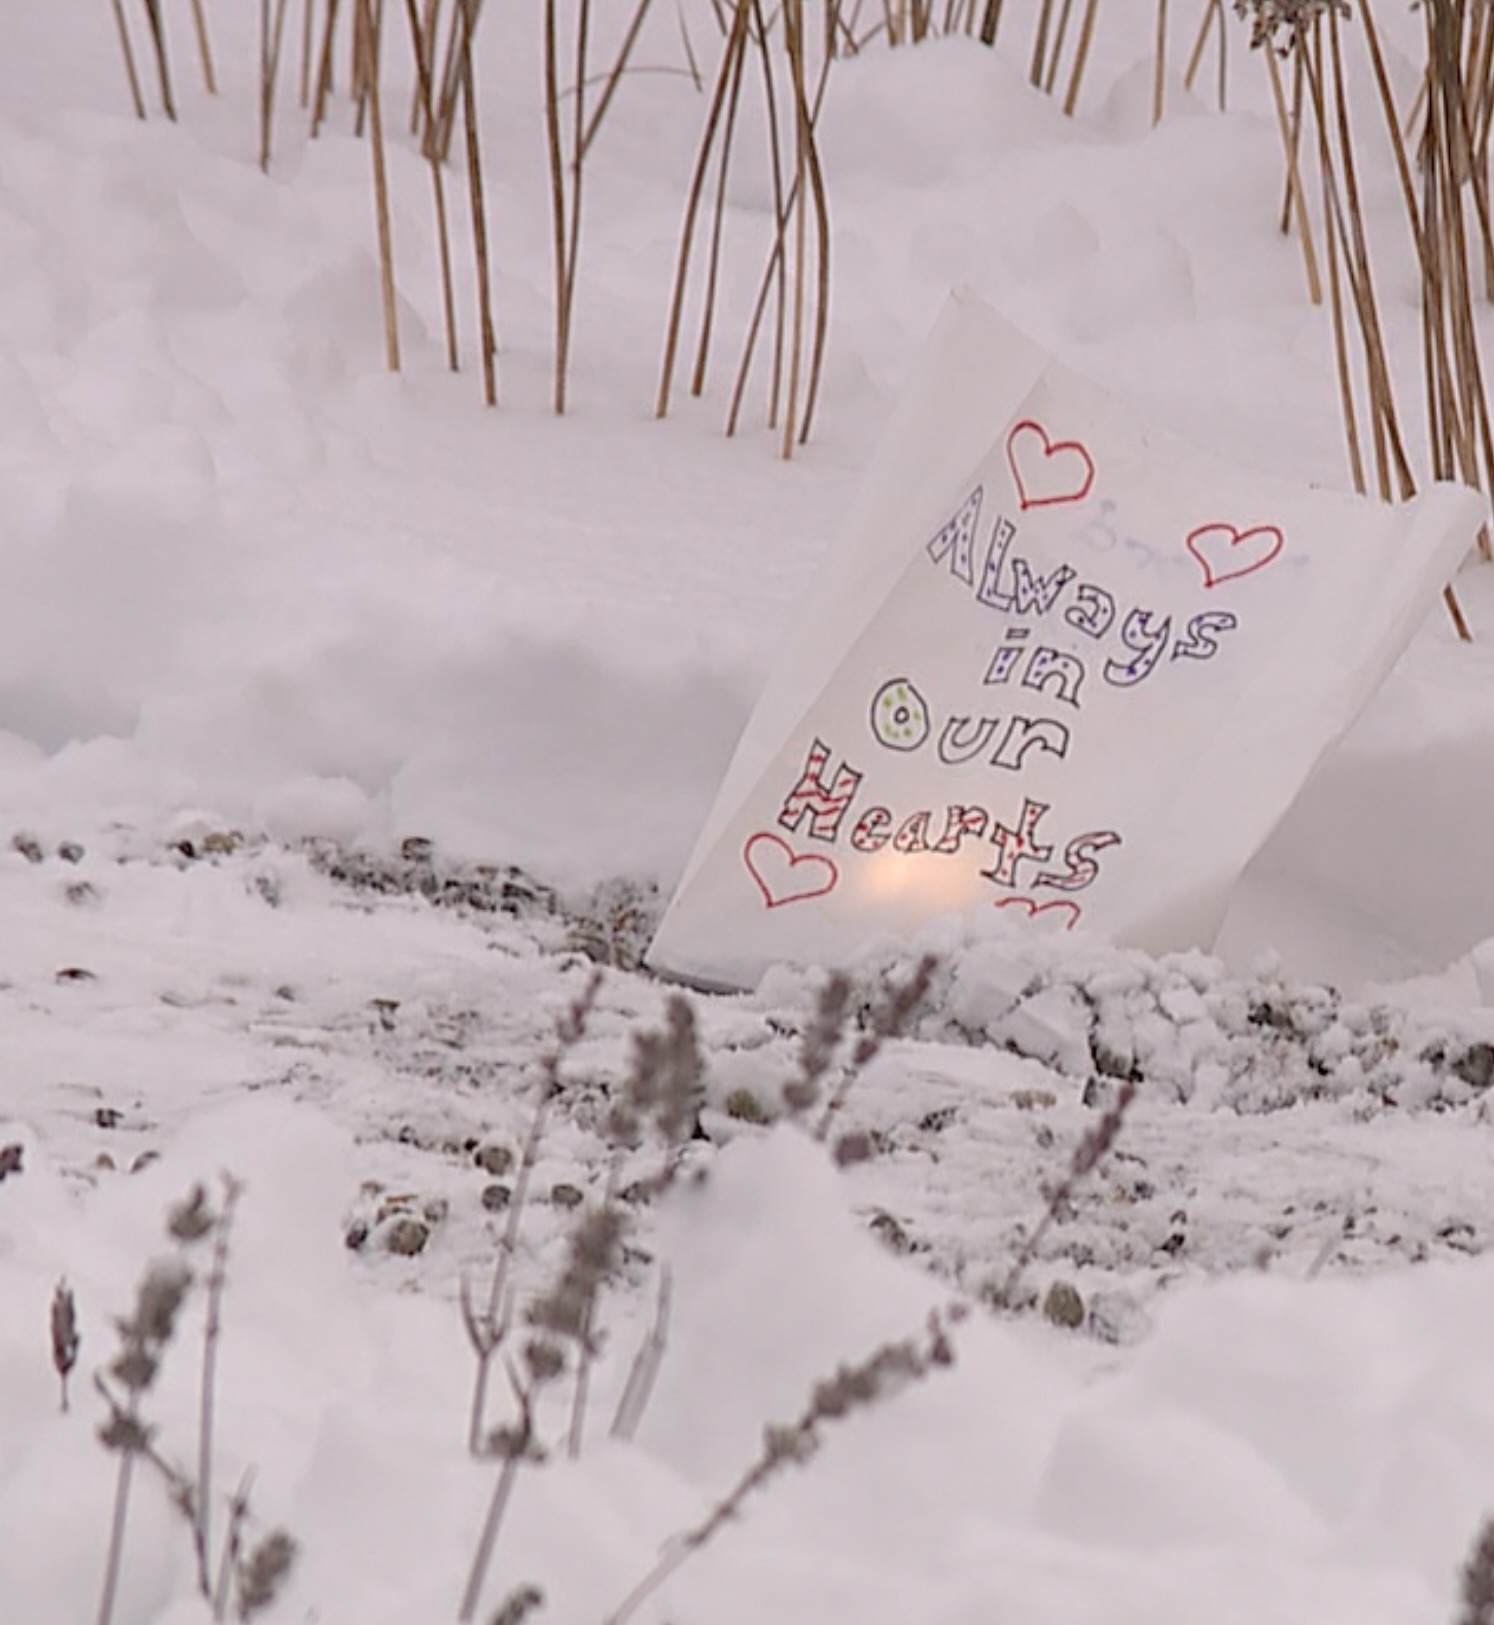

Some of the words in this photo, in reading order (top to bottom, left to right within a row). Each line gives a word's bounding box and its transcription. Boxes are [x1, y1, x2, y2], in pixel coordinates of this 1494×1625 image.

[984, 629, 1080, 707] in
[870, 677, 1069, 769] Our
[777, 737, 1121, 892] Hearts
